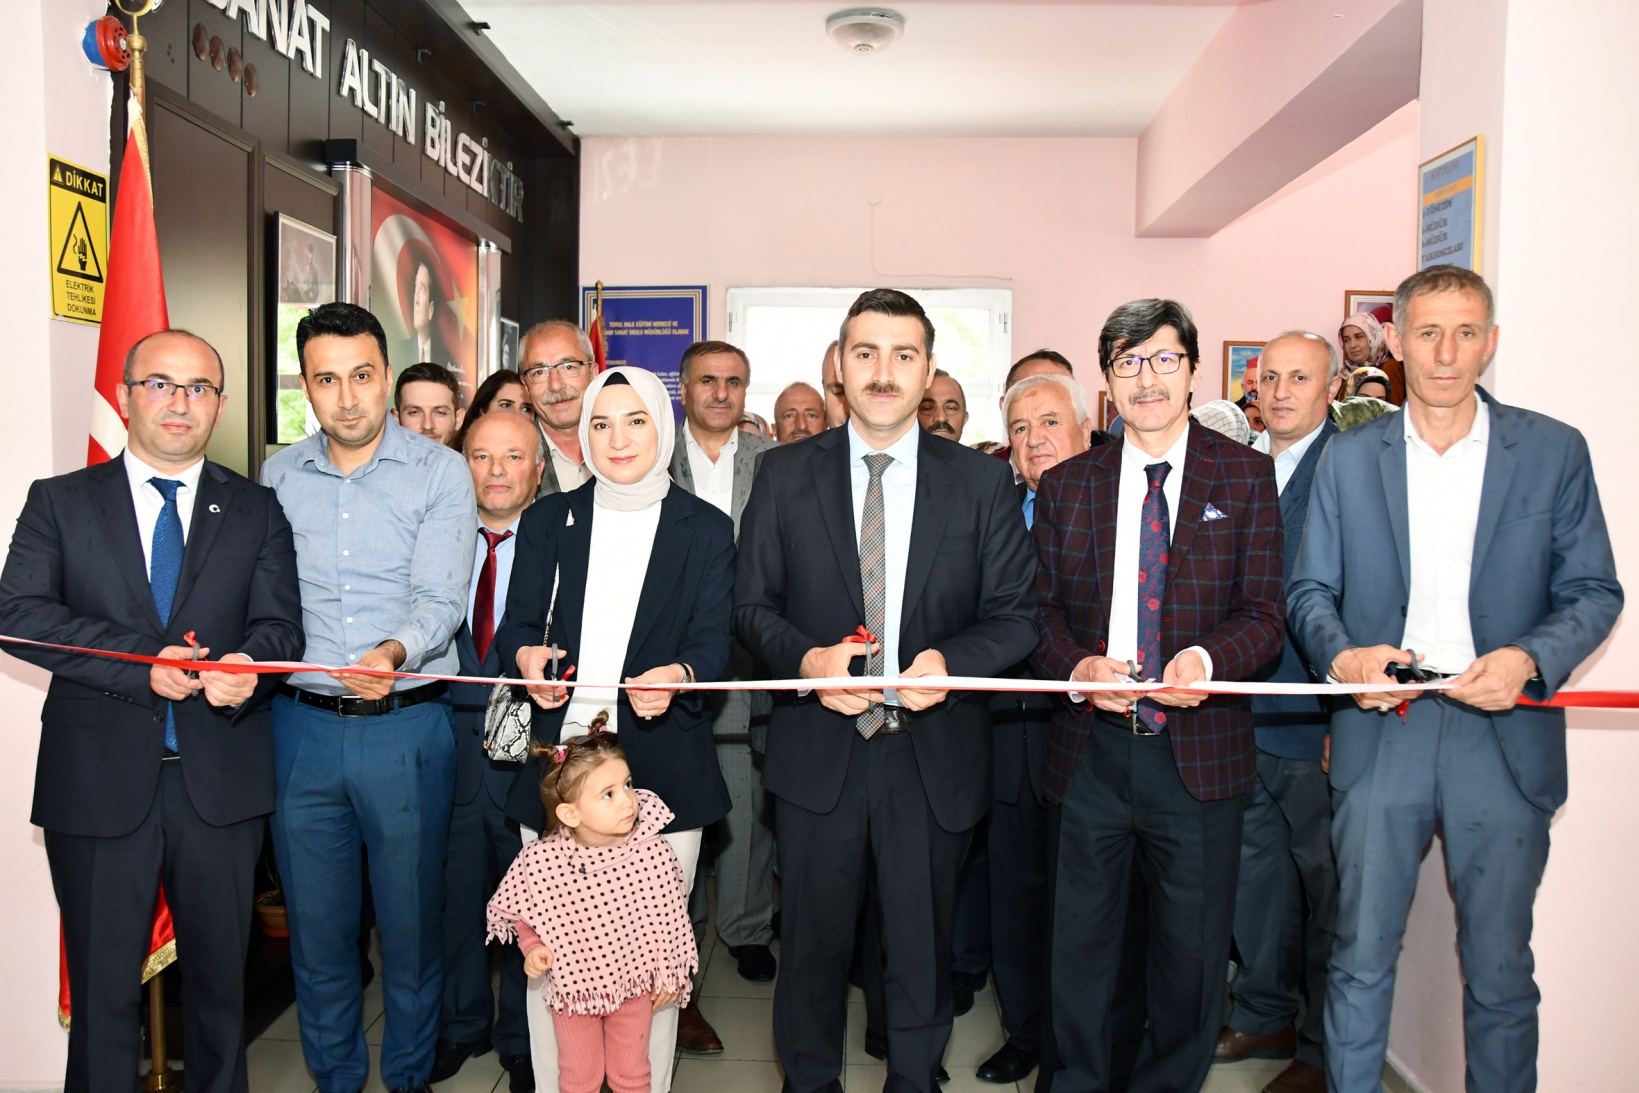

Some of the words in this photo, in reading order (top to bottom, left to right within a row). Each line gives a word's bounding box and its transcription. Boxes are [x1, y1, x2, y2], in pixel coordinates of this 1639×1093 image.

[339, 37, 417, 146] ALTIN
[424, 100, 524, 224] BİLEZİKTİR
[65, 170, 104, 198] DİKKAT
[65, 279, 95, 294] ELEKTRİK
[66, 291, 96, 305] TEHLİKESİ
[67, 303, 97, 317] DOKUNMA
